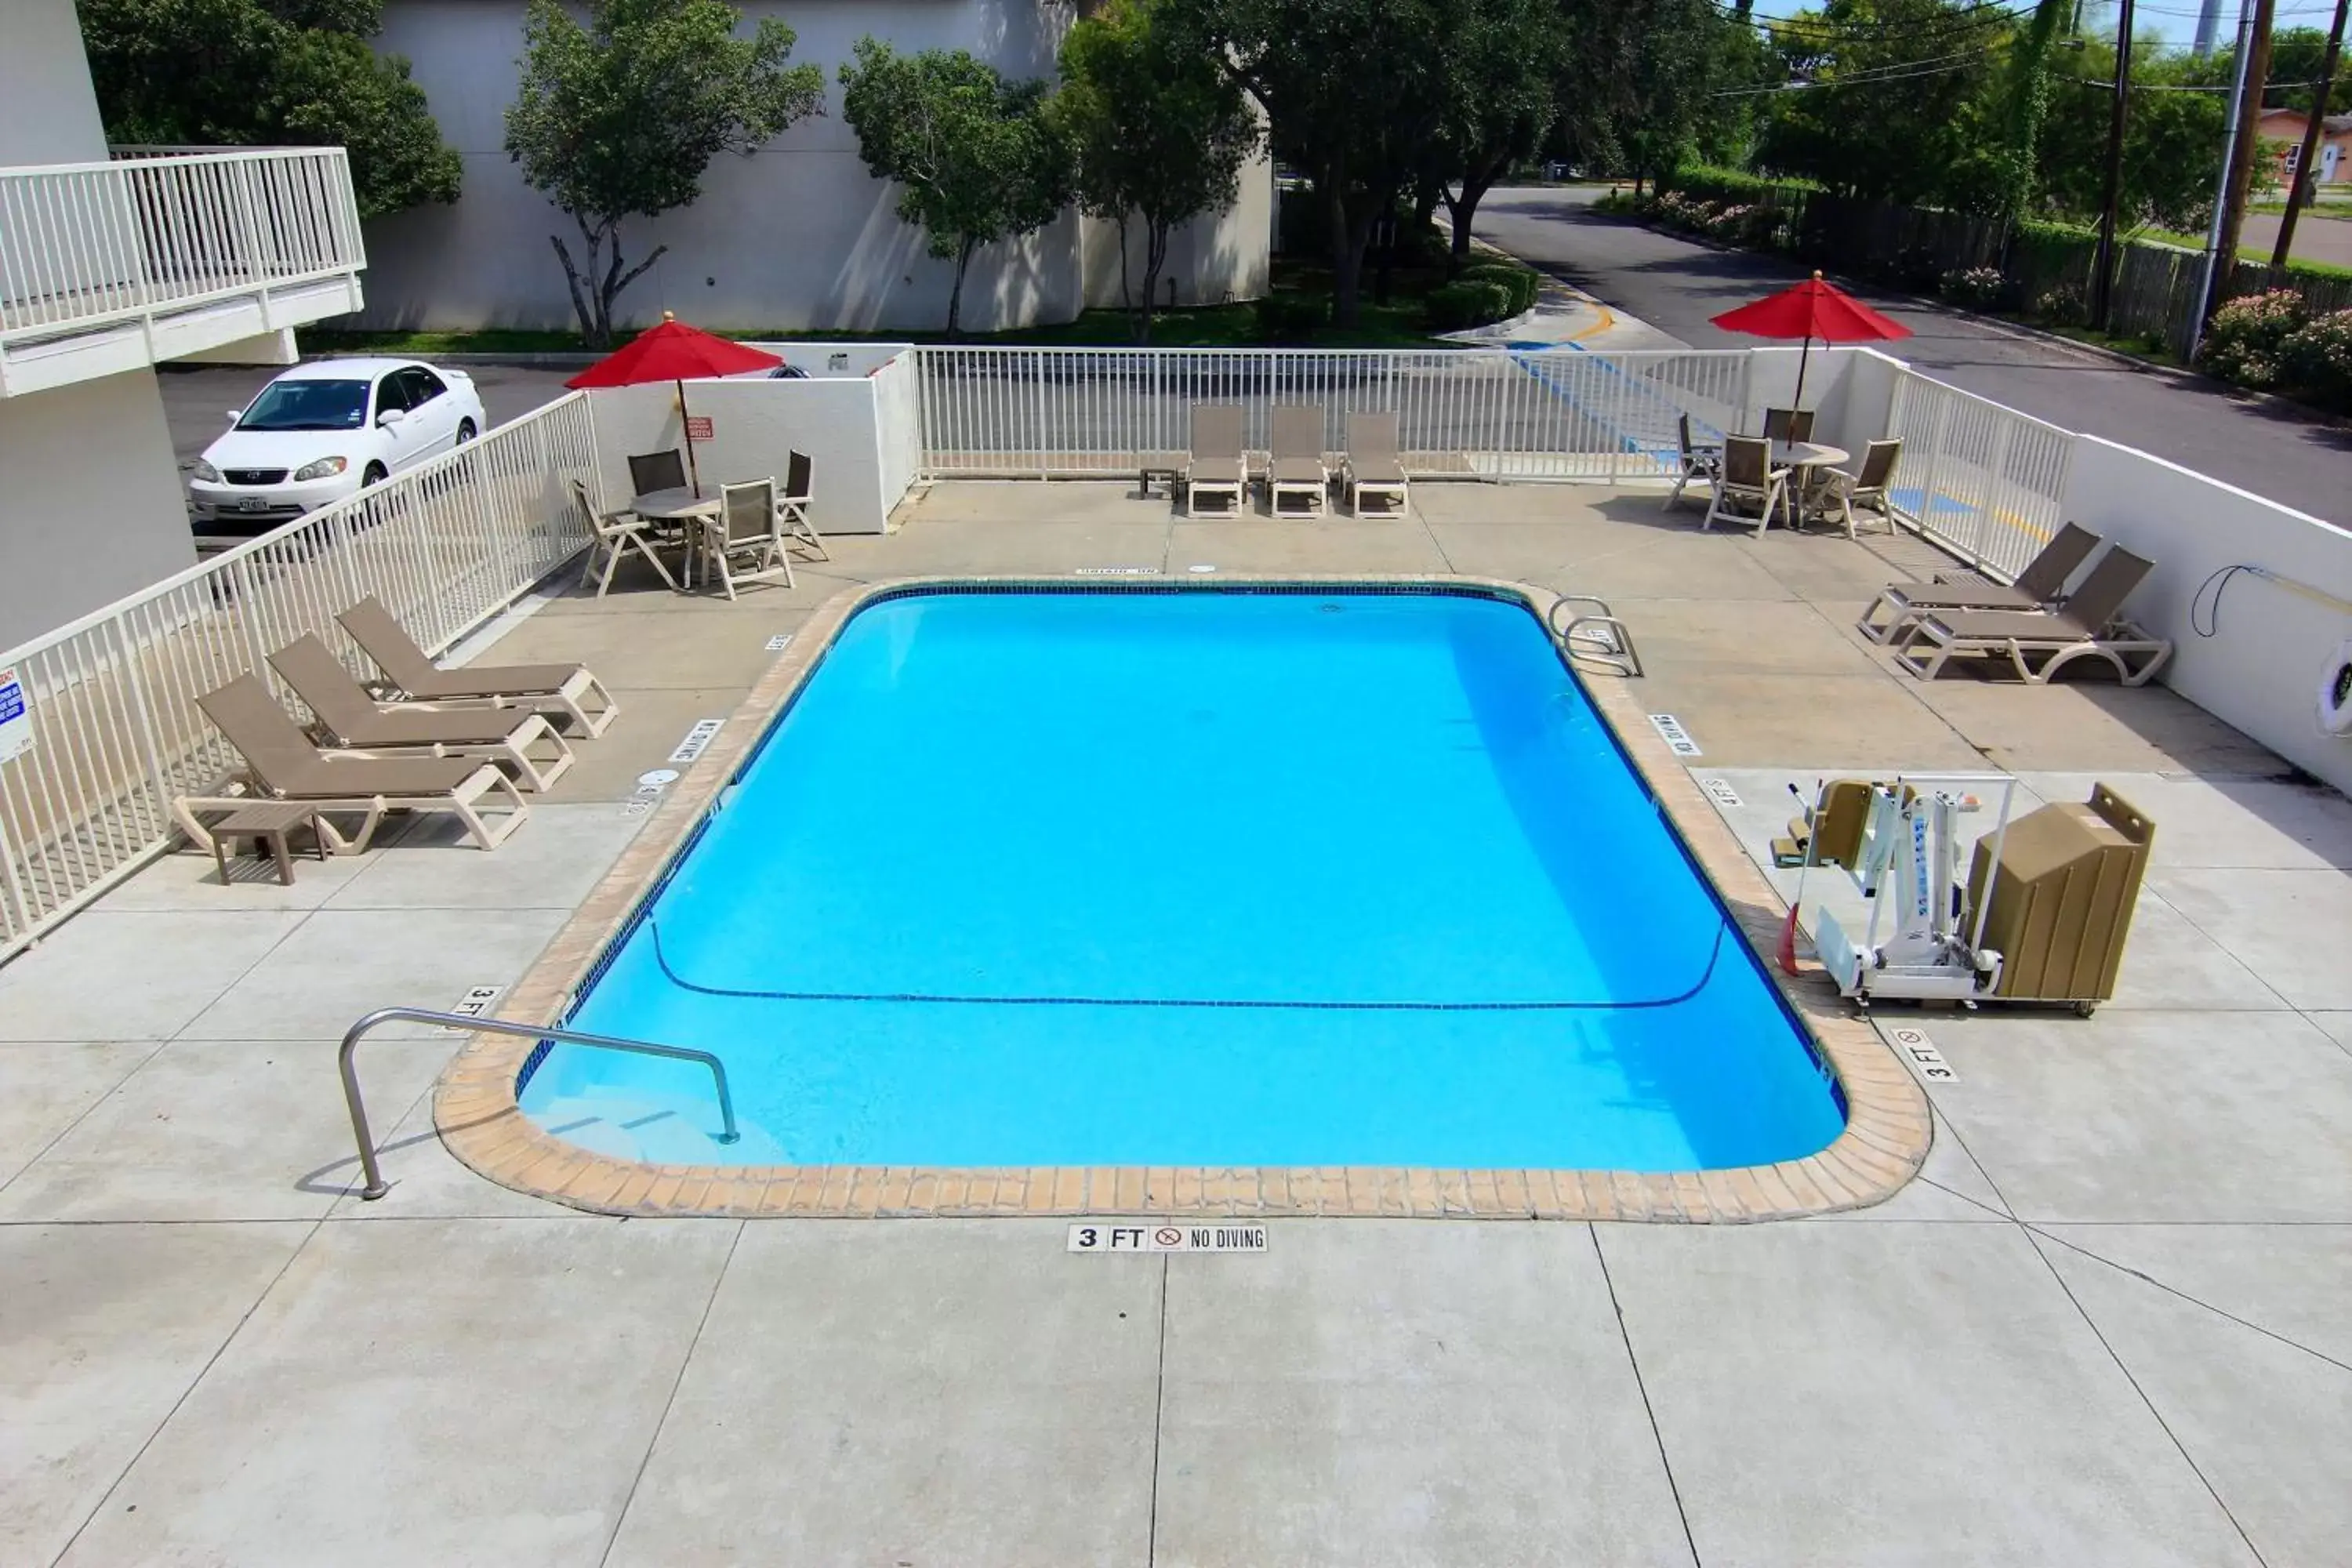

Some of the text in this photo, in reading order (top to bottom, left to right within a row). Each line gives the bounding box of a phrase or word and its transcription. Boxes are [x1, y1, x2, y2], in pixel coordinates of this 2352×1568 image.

[1909, 1047, 1951, 1078] 3 FT
[1078, 1229, 1264, 1247] 3 FT NO DIVING
